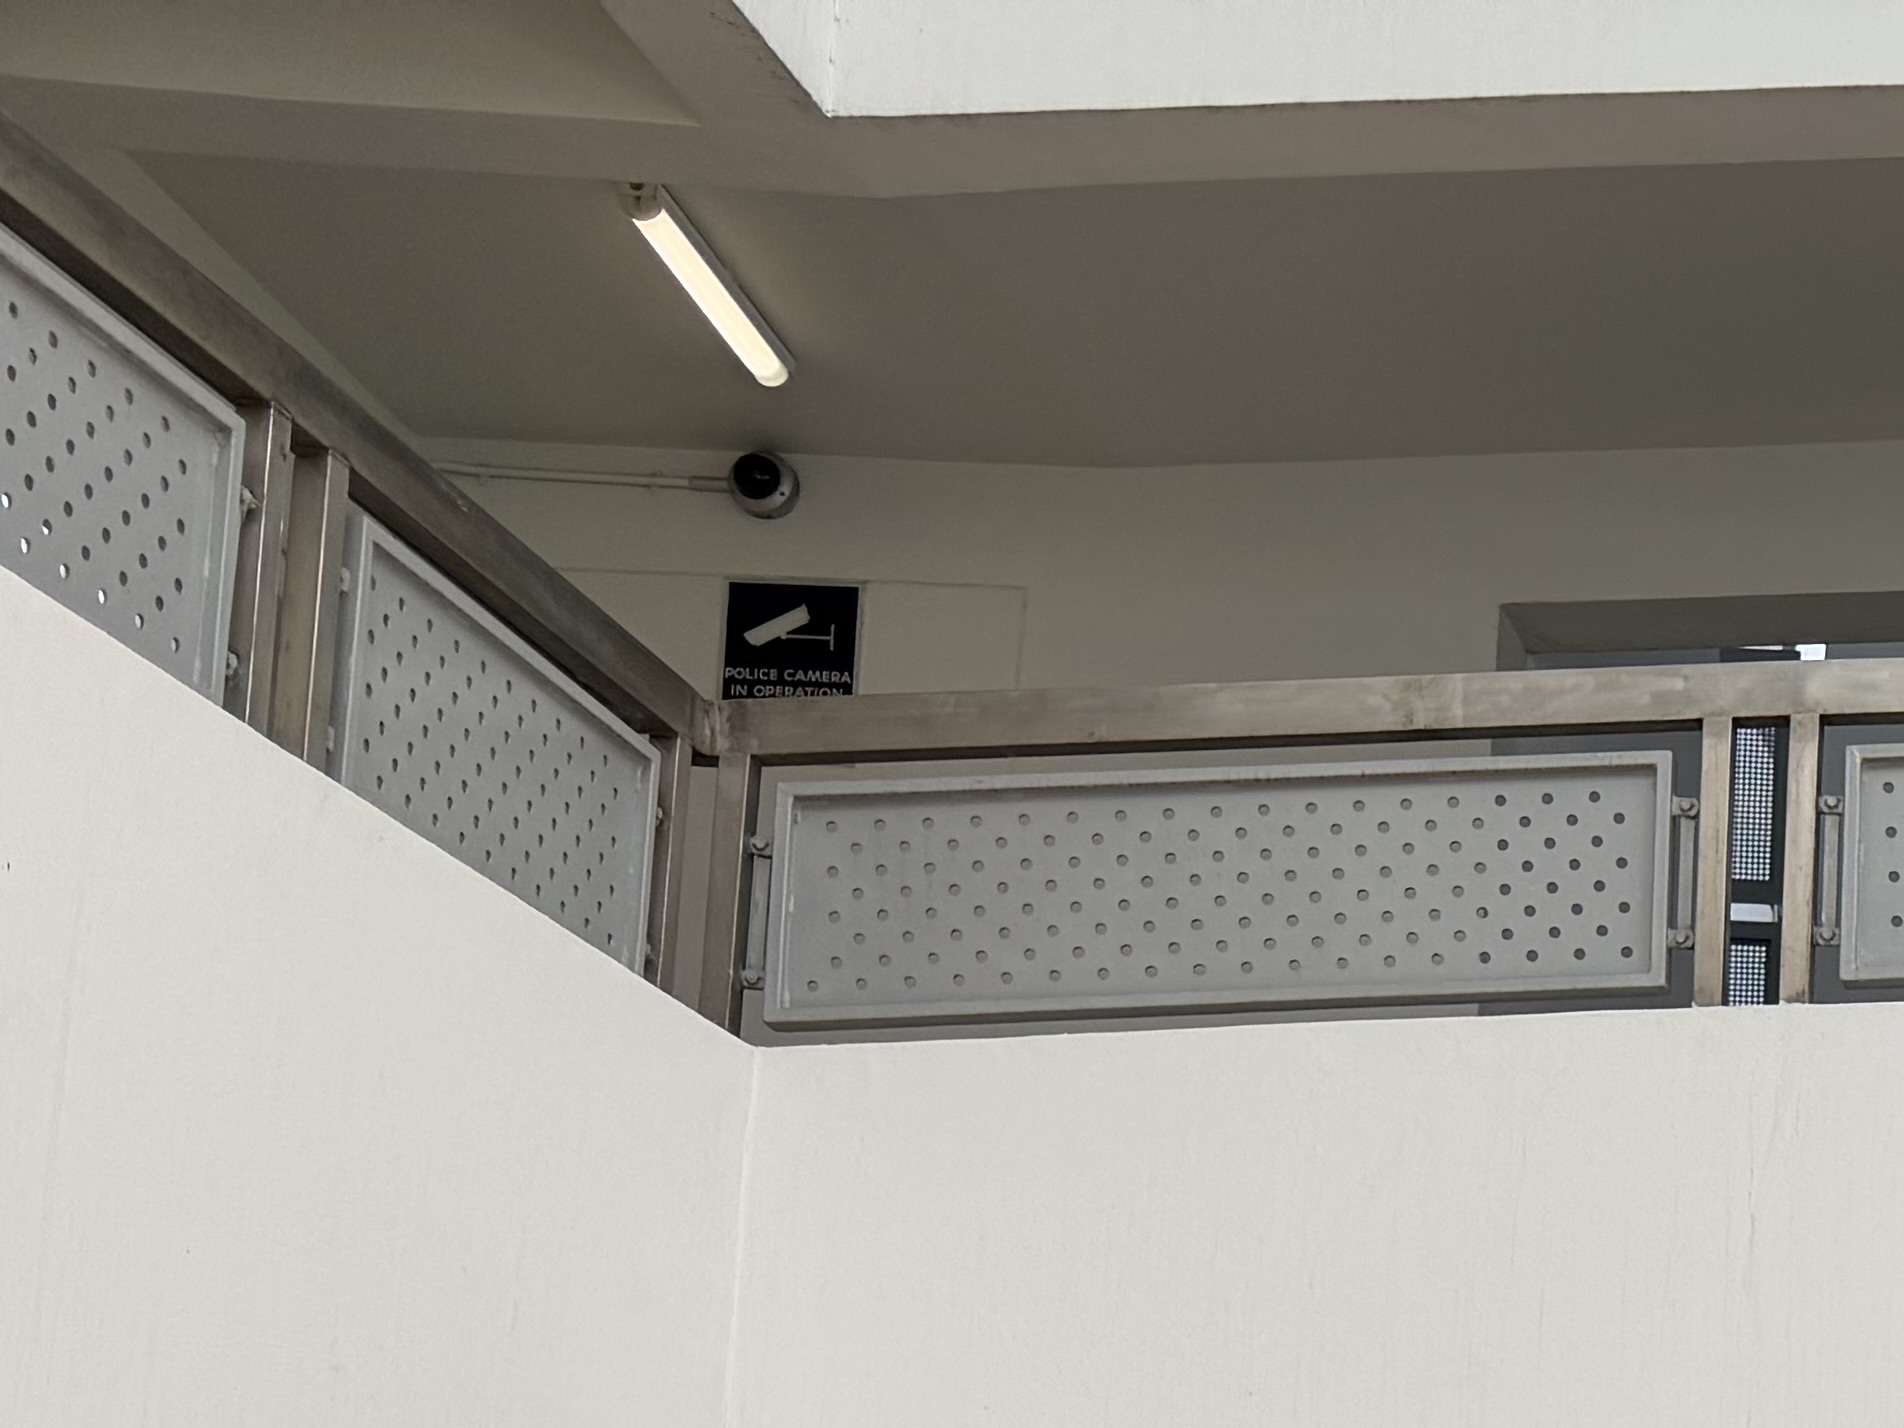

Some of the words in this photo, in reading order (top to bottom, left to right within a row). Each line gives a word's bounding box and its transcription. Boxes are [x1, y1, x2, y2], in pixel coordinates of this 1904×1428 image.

[725, 667, 778, 681] POLICE
[783, 669, 852, 684] CAMERA
[731, 684, 748, 696] IN
